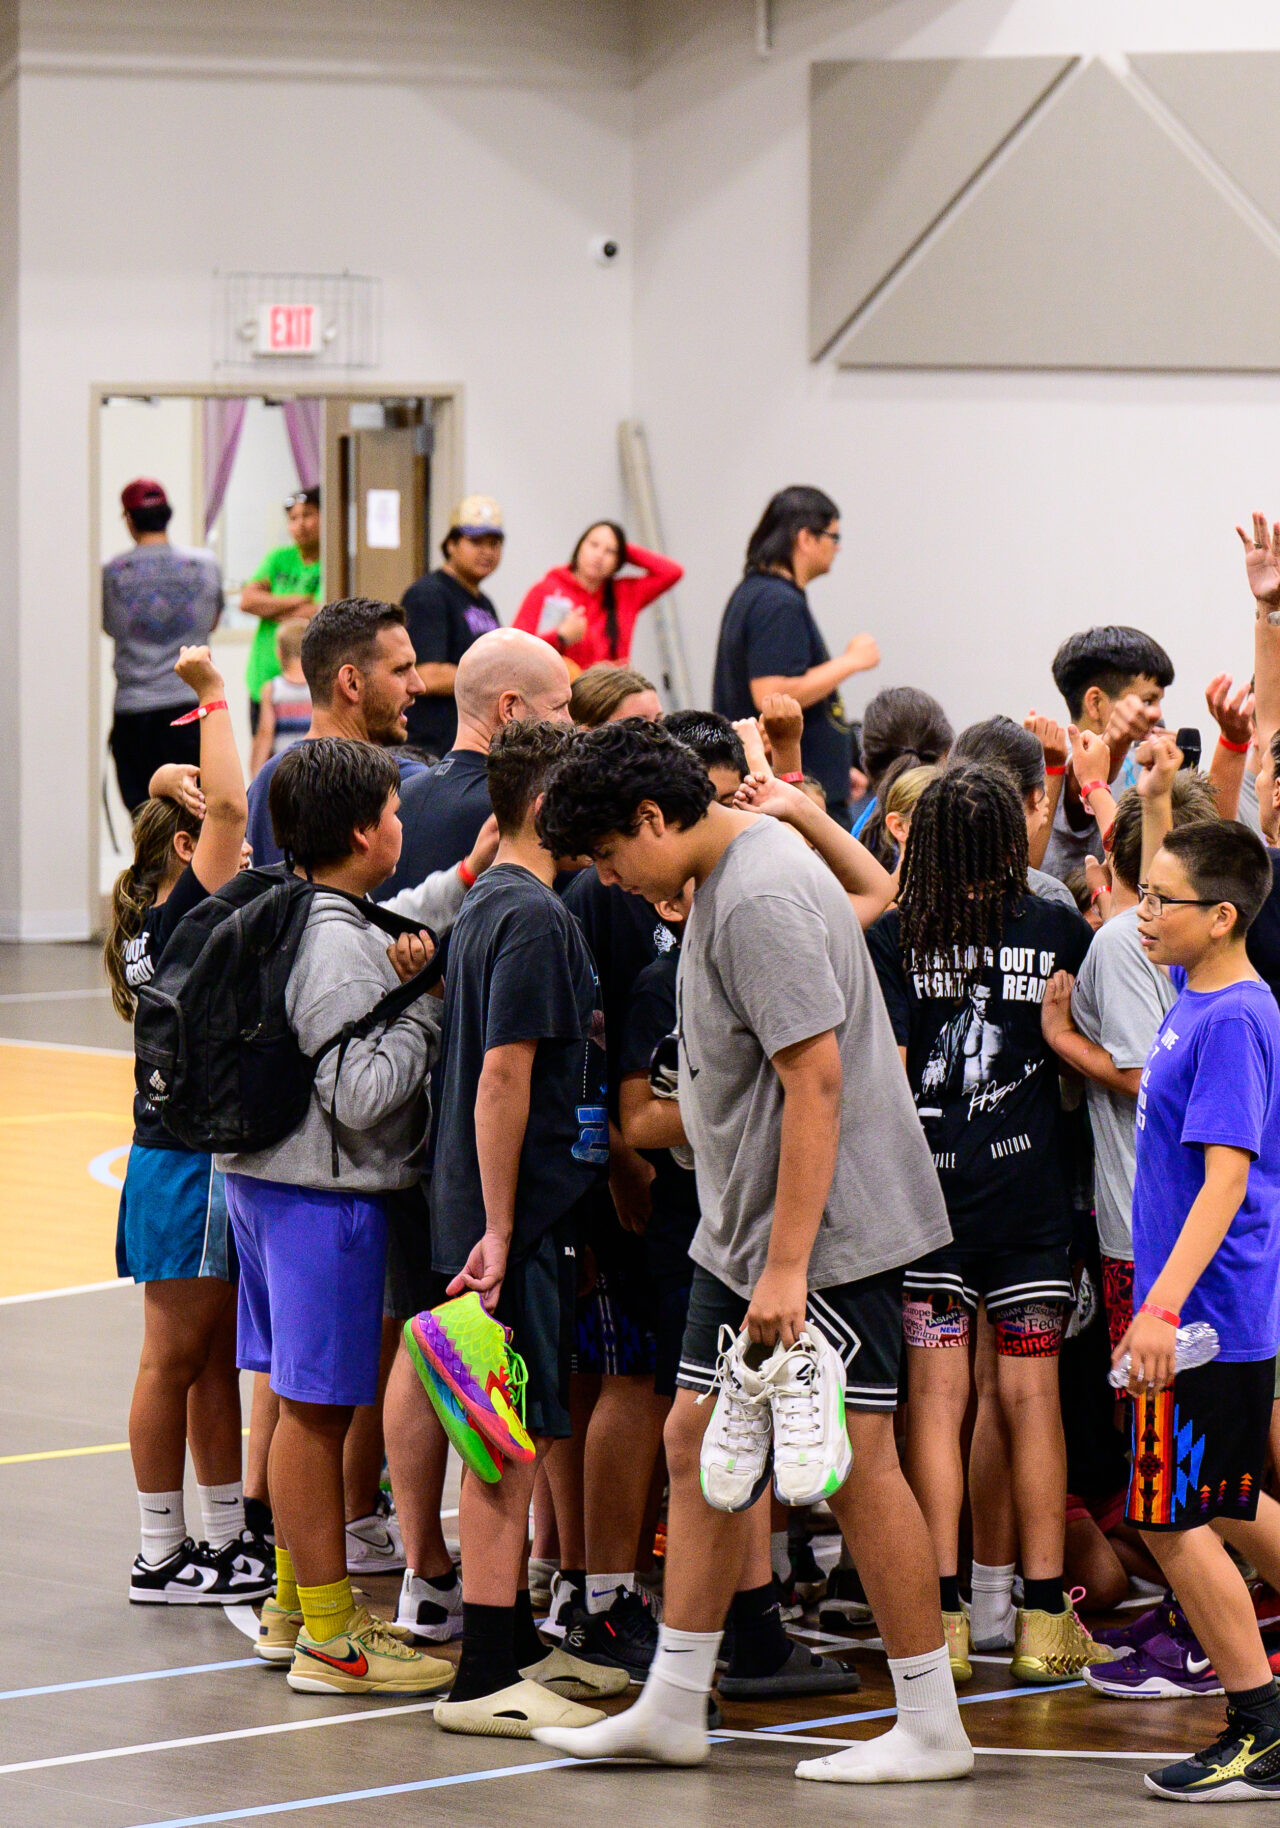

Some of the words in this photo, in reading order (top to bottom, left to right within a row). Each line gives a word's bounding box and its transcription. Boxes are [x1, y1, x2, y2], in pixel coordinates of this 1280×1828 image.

[270, 306, 314, 346] EXIT
[1000, 947, 1035, 973] OUT
[1039, 950, 1055, 977] OF
[1002, 974, 1047, 1003] READ
[990, 1133, 1032, 1159] ARIZONA
[928, 1310, 959, 1326] ASIAN
